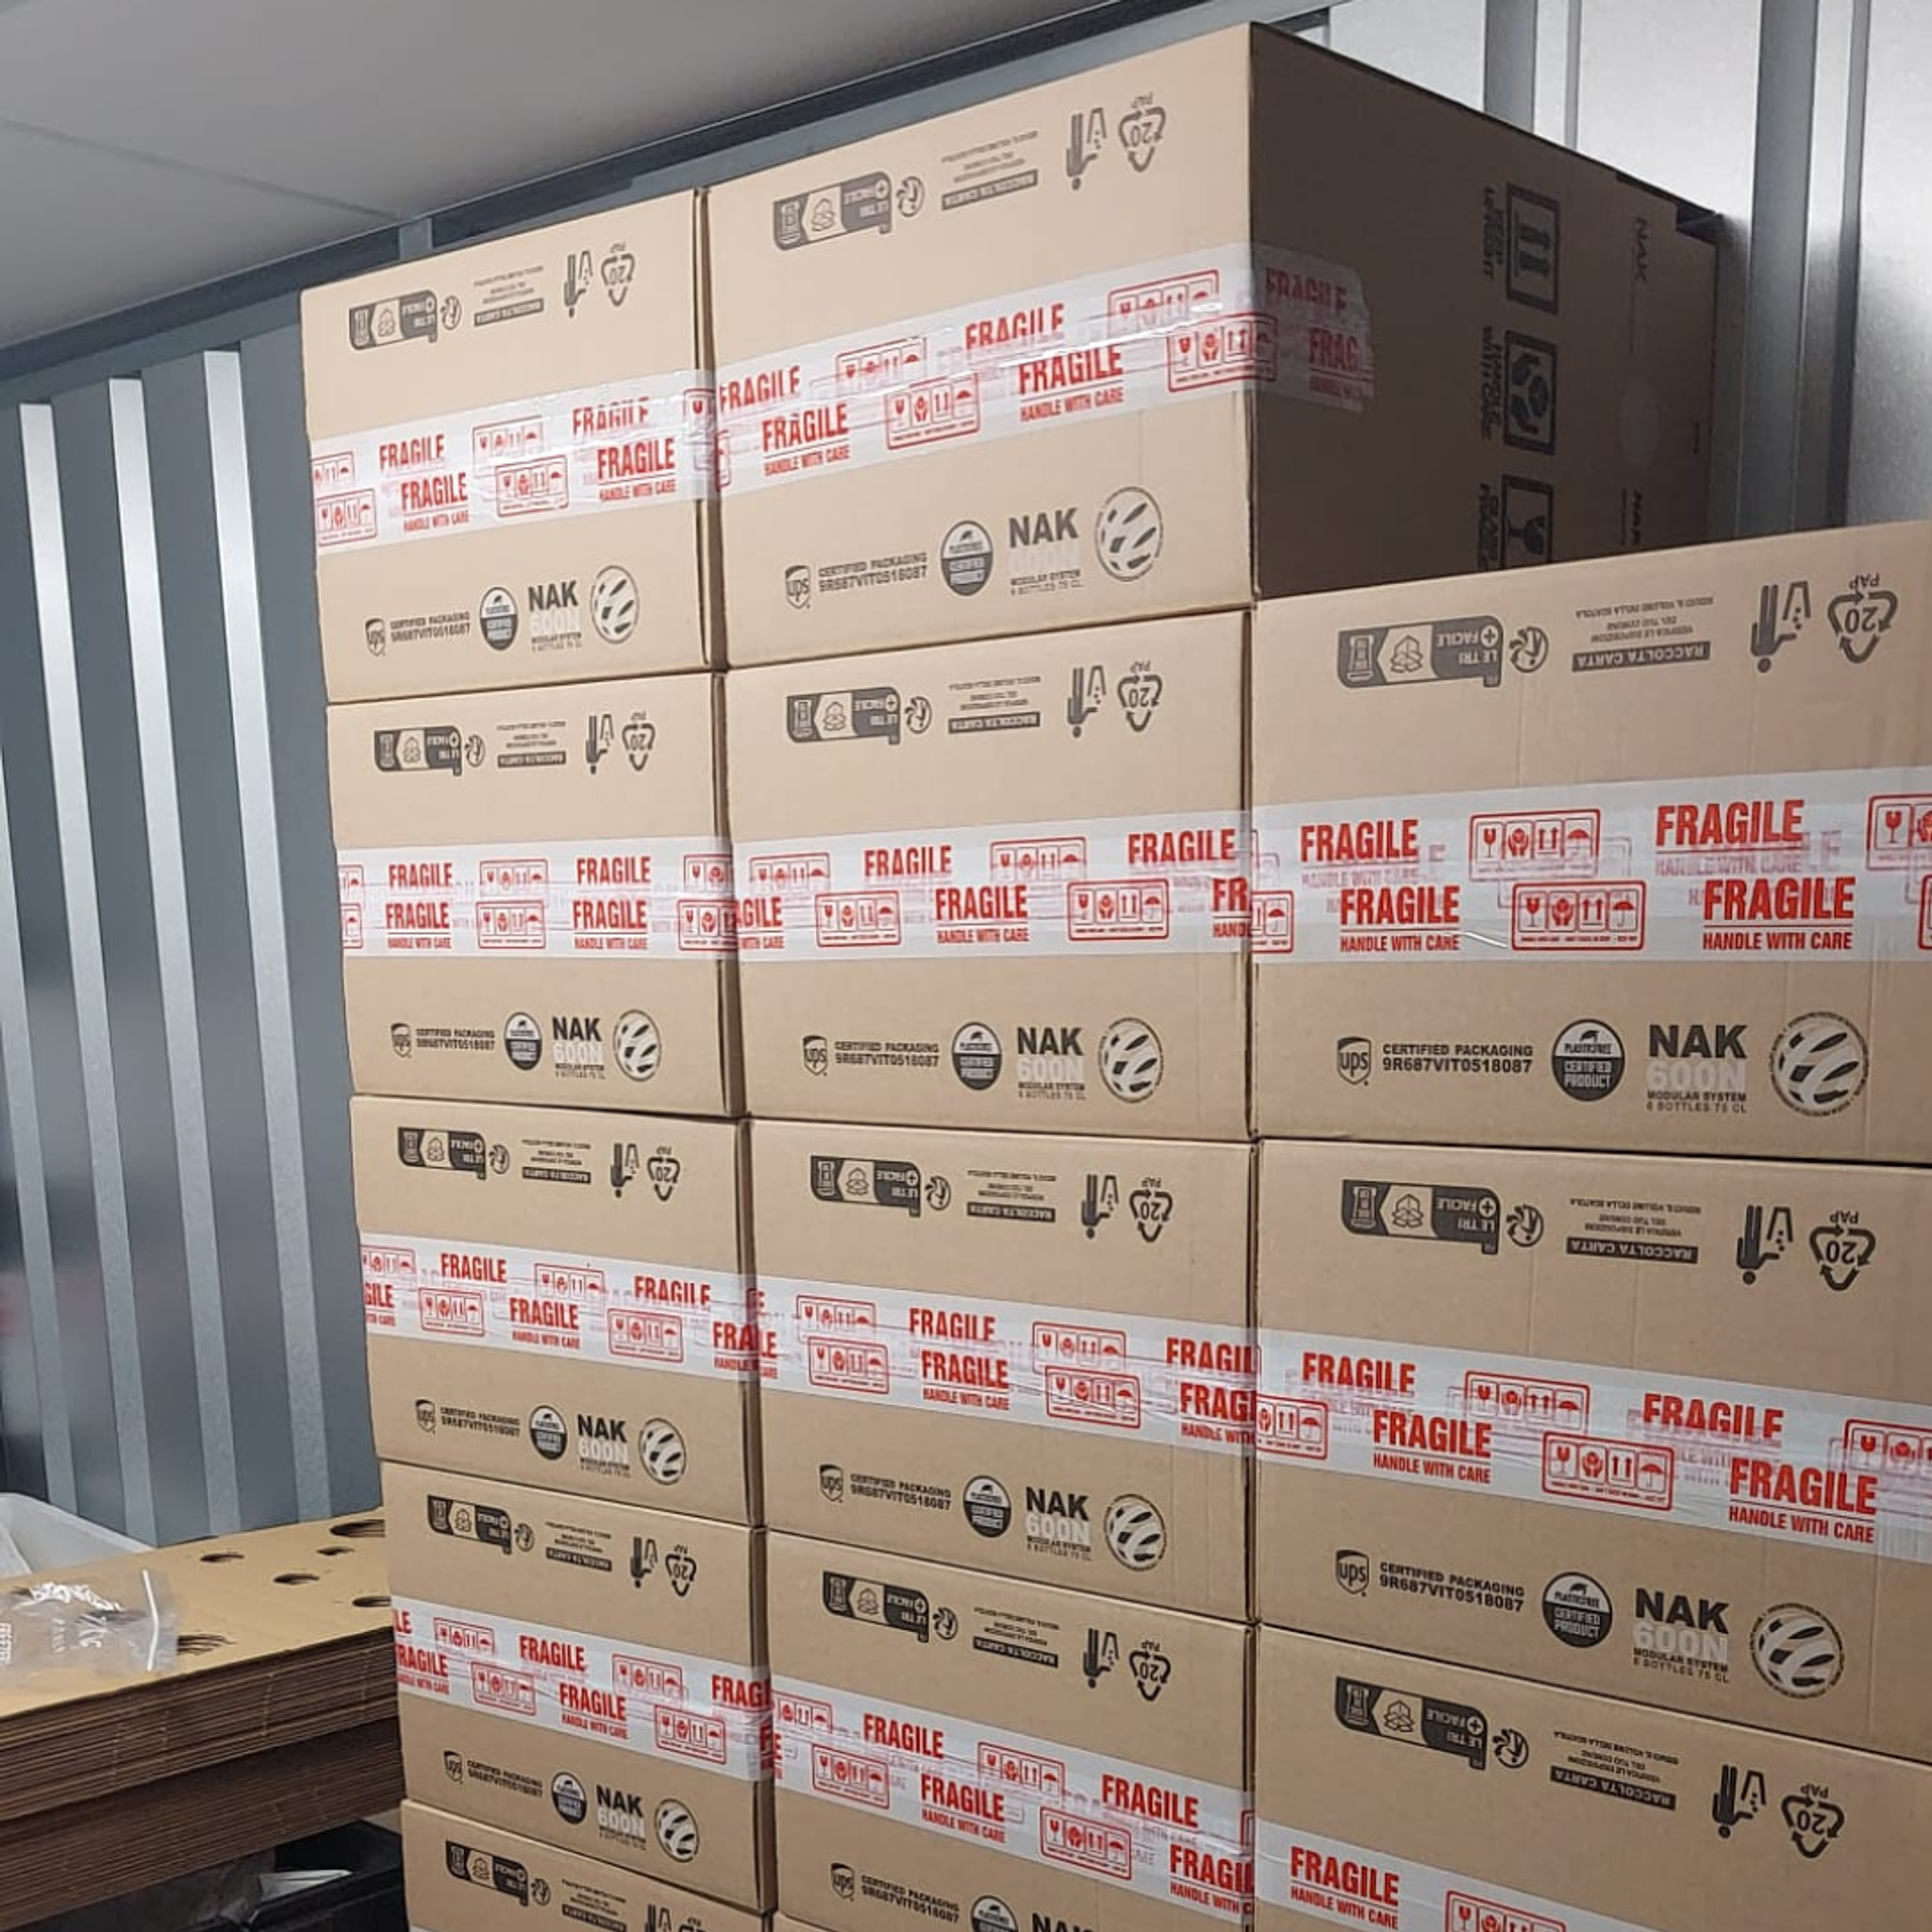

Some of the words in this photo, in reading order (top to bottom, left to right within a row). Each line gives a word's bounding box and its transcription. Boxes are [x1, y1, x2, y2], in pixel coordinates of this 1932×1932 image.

[1130, 122, 1155, 146] 20
[966, 303, 1063, 351] FRAGILE
[1019, 344, 1124, 394] FRAGILE
[720, 366, 800, 415] FRAGILE
[573, 396, 649, 436] FRAGILE
[1020, 401, 1061, 422] HANDLE
[1065, 394, 1091, 414] WITH
[1094, 387, 1124, 408] CARE
[762, 403, 848, 452] FRAGILE
[380, 433, 444, 470] FRAGILE
[597, 438, 675, 479] FRAGILE
[401, 473, 468, 511] FRAGILE
[1009, 508, 1078, 548] NAK
[819, 561, 866, 576] CERTIFIED
[1850, 574, 1879, 589] PAP
[528, 581, 577, 612] NAK
[1843, 607, 1879, 632] 20
[1436, 630, 1478, 646] FACILE
[1131, 661, 1150, 672] PAP
[1459, 652, 1480, 665] TRI
[1484, 650, 1497, 663] LE
[1576, 653, 1624, 669] CARTA
[1627, 643, 1706, 664] RACCOLTA
[1128, 687, 1150, 707] 20
[1657, 800, 1804, 846] FRAGILE
[1128, 829, 1235, 863] FRAGILE
[1301, 819, 1419, 862] FRAGILE
[577, 857, 651, 884] FRAGILE
[865, 845, 951, 876] FRAGILE
[389, 863, 452, 888] FRAGILE
[936, 885, 1027, 920] FRAGILE
[1341, 885, 1460, 924] FRAGILE
[1705, 877, 1856, 920] FRAGILE
[386, 902, 450, 929] FRAGILE
[574, 900, 646, 929] FRAGILE
[938, 929, 974, 943] HANDLE
[977, 928, 1000, 943] WITH
[1003, 927, 1029, 942] CARE
[1341, 936, 1388, 952] HANDLE
[1392, 935, 1422, 952] WITH
[1426, 934, 1458, 951] CARE
[1704, 933, 1760, 951] HANDLE
[1767, 932, 1805, 950] WITH
[1809, 932, 1852, 950] CARE
[553, 1017, 601, 1041] NAK
[1017, 1027, 1083, 1056] NAK
[1649, 1024, 1746, 1058] NAK
[836, 1042, 880, 1052] CERTIFIED
[885, 1042, 939, 1053] PACKAGING
[1383, 1043, 1449, 1057] CERTIFIED
[1456, 1043, 1533, 1057] PACKAGING
[1017, 1057, 1085, 1082] 600N
[1383, 1057, 1533, 1073] 9R687VIT0518087
[1566, 1061, 1612, 1073] CERTIFIED
[1646, 1059, 1745, 1091] 600N
[1566, 1074, 1611, 1088] PRODUCT
[1648, 1091, 1699, 1101] MODULAR
[1704, 1091, 1745, 1102] SYSTEM
[1141, 1177, 1161, 1187] PAP
[1141, 1202, 1160, 1220] 20
[1438, 1196, 1477, 1212] FACILE
[1458, 1215, 1477, 1230] TRI
[1480, 1218, 1496, 1232] LE
[1830, 1210, 1858, 1226] PAP
[1571, 1240, 1616, 1255] CARTA
[1620, 1242, 1692, 1260] RACCOLTA
[1826, 1240, 1856, 1265] 20
[441, 1254, 506, 1283] FRAGILE
[635, 1276, 710, 1307] FRAGILE
[509, 1298, 578, 1330] FRAGILE
[909, 1307, 994, 1341] FRAGILE
[541, 1334, 559, 1347] WITH
[561, 1337, 580, 1350] CARE
[923, 1350, 1008, 1389] FRAGILE
[1303, 1352, 1415, 1393] FRAGILE
[924, 1387, 958, 1403] HANDLE
[960, 1391, 985, 1407] WITH
[989, 1394, 1009, 1410] CARE
[578, 1414, 625, 1442] NAK
[1643, 1392, 1783, 1440] FRAGILE
[1181, 1423, 1222, 1441] HANDLE
[1373, 1411, 1491, 1457] FRAGILE
[579, 1441, 628, 1461] 600N
[1374, 1453, 1418, 1475] HANDLE
[1423, 1459, 1454, 1480] WITH
[1457, 1466, 1491, 1484] CARE
[851, 1474, 894, 1488] CERTIFIED
[900, 1481, 951, 1498] PACKAGING
[1730, 1457, 1875, 1516] FRAGILE
[1026, 1487, 1089, 1521] NAK
[1025, 1514, 1090, 1541] 600N
[1729, 1505, 1786, 1532] HANDLE
[1791, 1514, 1829, 1539] WITH
[1833, 1521, 1874, 1543] CARE
[672, 1561, 688, 1580] 20
[1380, 1562, 1443, 1583] CERTIFIED
[1449, 1574, 1524, 1597] PACKAGING
[1379, 1574, 1524, 1613] 9R687VIT0518087
[1555, 1608, 1601, 1624] CERTIFIED
[1636, 1589, 1728, 1634] NAK
[1555, 1620, 1599, 1639] PRODUCT
[520, 1635, 585, 1673] FRAGILE
[1141, 1639, 1160, 1651] PAP
[1633, 1625, 1728, 1662] 600N
[1139, 1662, 1158, 1681] 20
[1634, 1648, 1683, 1665] MODULAR
[1687, 1657, 1728, 1674] SYSTEM
[560, 1683, 626, 1721] FRAGILE
[591, 1720, 607, 1735] WITH
[609, 1724, 627, 1740] CARE
[1427, 1709, 1466, 1728] FACILE
[863, 1713, 943, 1759] FRAGILE
[1446, 1728, 1465, 1744] TRI
[1466, 1733, 1483, 1749] LE
[1555, 1769, 1598, 1790] CARTA
[1602, 1779, 1672, 1807] RACCOLTA
[1802, 1783, 1828, 1798] PAP
[597, 1785, 643, 1816] NAK
[922, 1774, 1004, 1823] FRAGILE
[1102, 1774, 1198, 1827] FRAGILE
[598, 1811, 646, 1836] 600N
[922, 1808, 955, 1831] HANDLE
[958, 1819, 979, 1838] WITH
[983, 1824, 1005, 1843] CARE
[1797, 1811, 1824, 1836] 20
[1291, 1846, 1399, 1907] FRAGILE
[861, 1874, 905, 1896] CERTIFIED
[908, 1888, 959, 1912] PACKAGING
[1171, 1882, 1209, 1904] HANDLE
[1212, 1892, 1239, 1913] WITH
[1291, 1887, 1334, 1914] HANDLE
[1338, 1900, 1364, 1923] WITH
[1369, 1907, 1399, 1930] CARE
